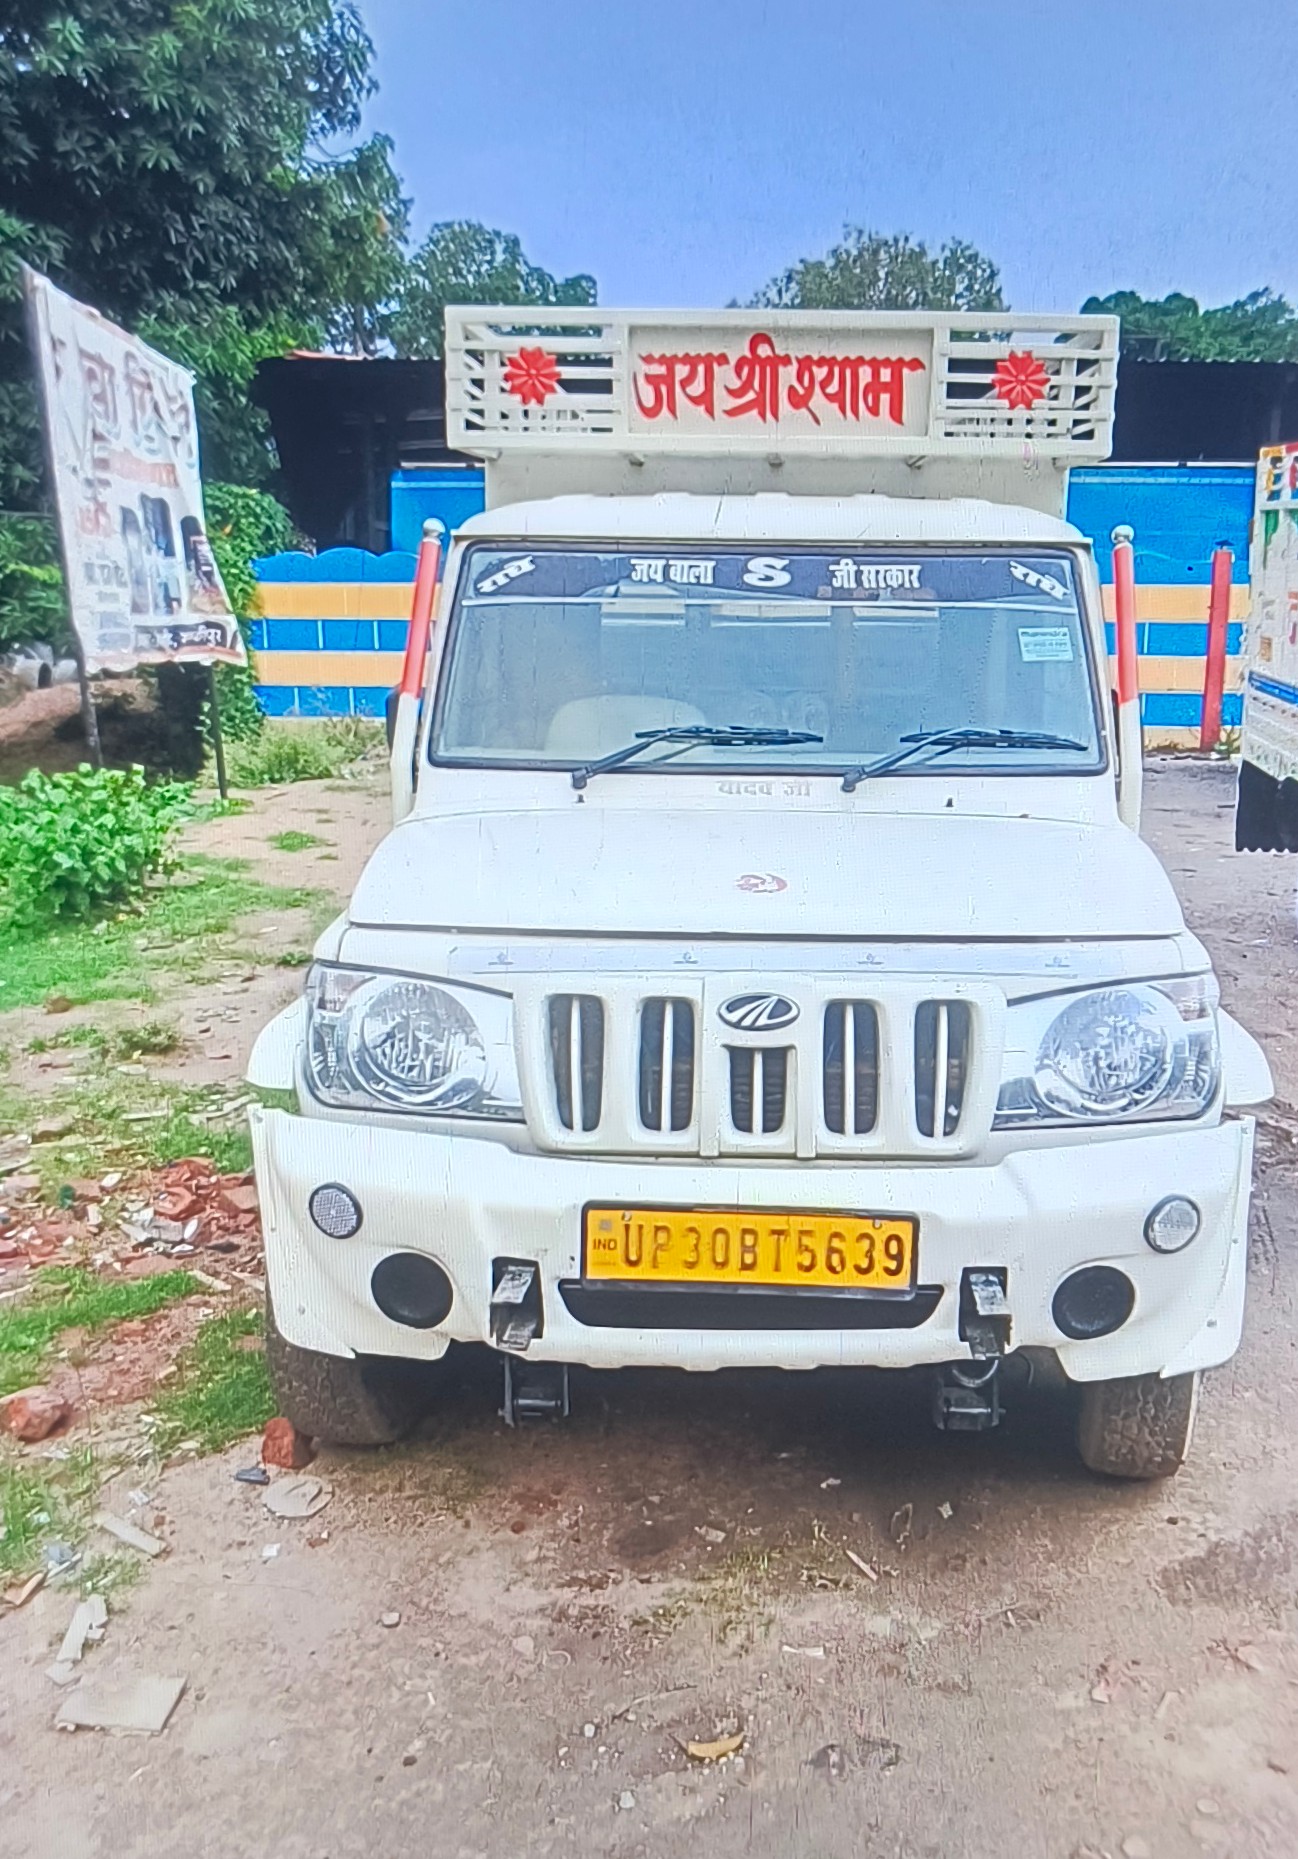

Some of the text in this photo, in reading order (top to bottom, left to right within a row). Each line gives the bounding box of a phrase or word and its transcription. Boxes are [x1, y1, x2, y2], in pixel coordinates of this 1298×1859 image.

[634, 332, 926, 426] जय श्री श्याम
[630, 558, 667, 583] जय
[667, 560, 716, 584] बाला
[828, 558, 857, 589] जी
[859, 564, 921, 589] सरकार
[592, 1238, 618, 1252] IND
